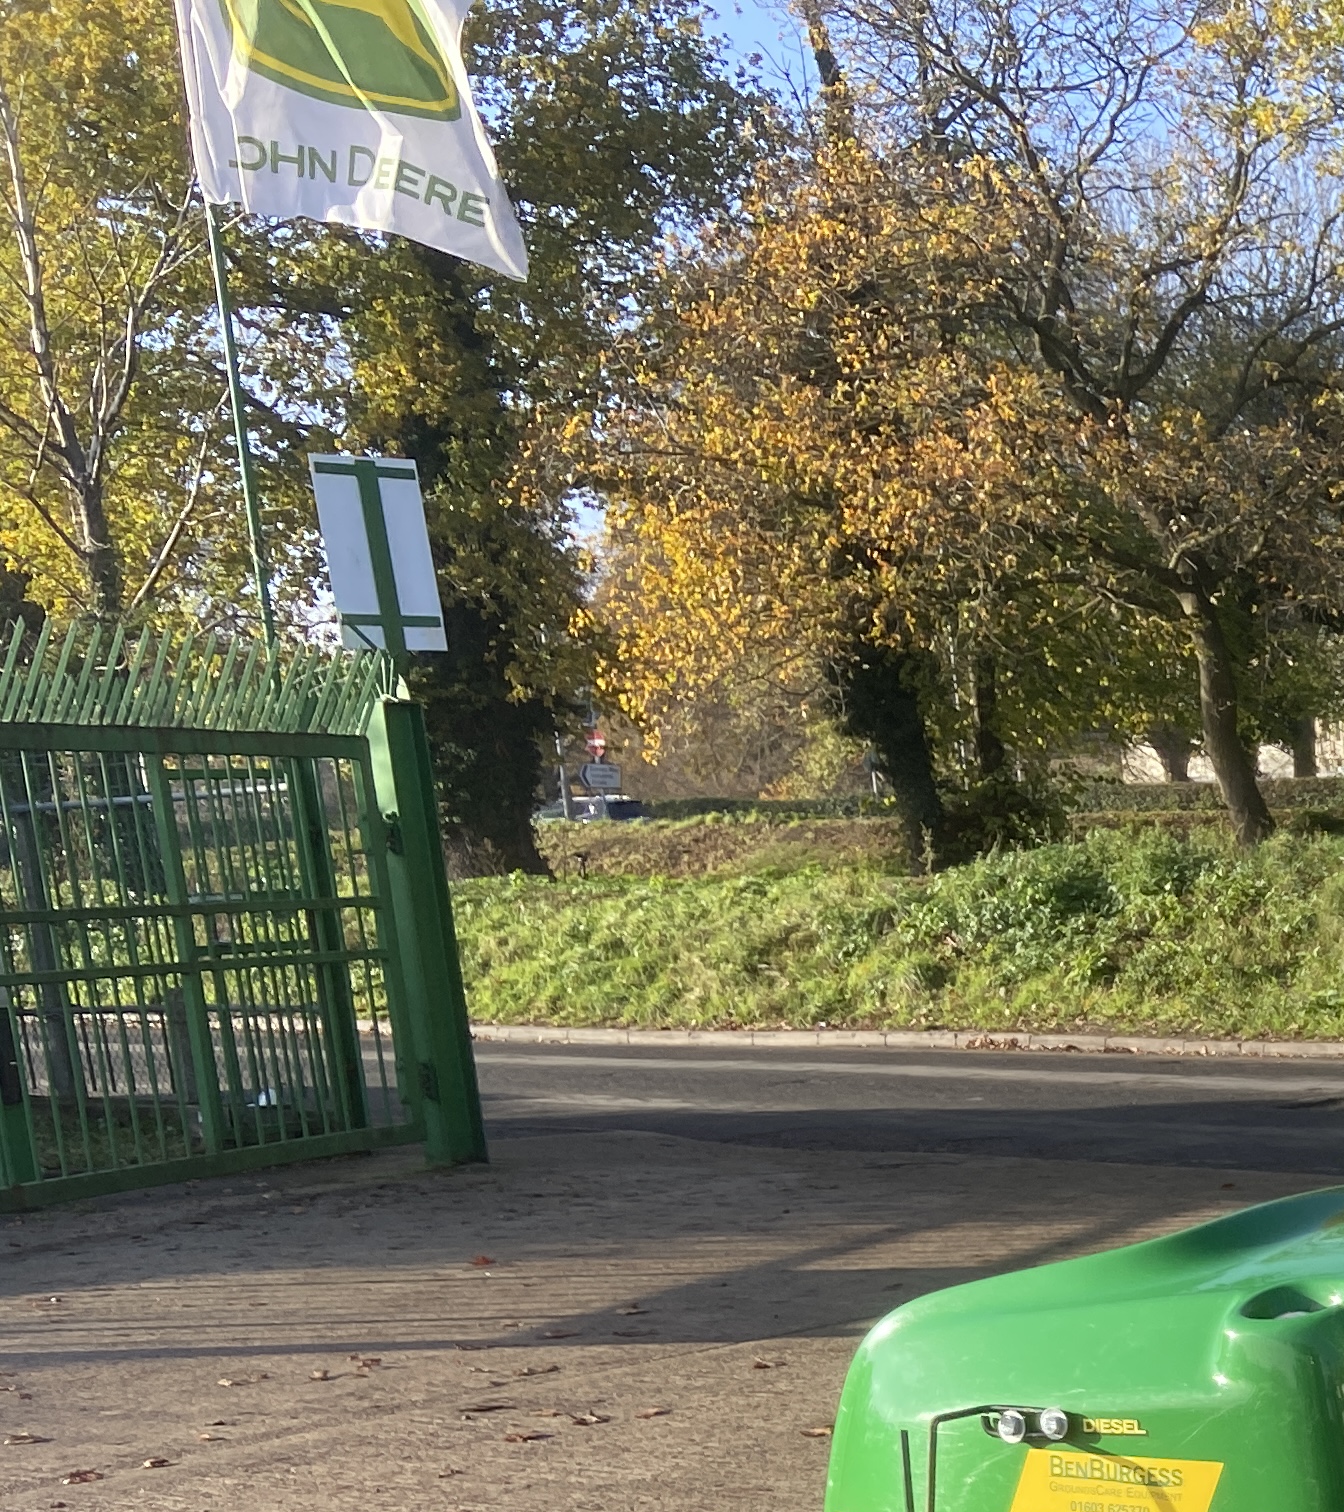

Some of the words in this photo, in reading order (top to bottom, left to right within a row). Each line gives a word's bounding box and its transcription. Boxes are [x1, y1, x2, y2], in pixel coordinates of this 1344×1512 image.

[347, 144, 490, 228] DEERE
[1082, 1418, 1147, 1435] DIESEL
[1125, 1487, 1183, 1502] EQUIPMENT
